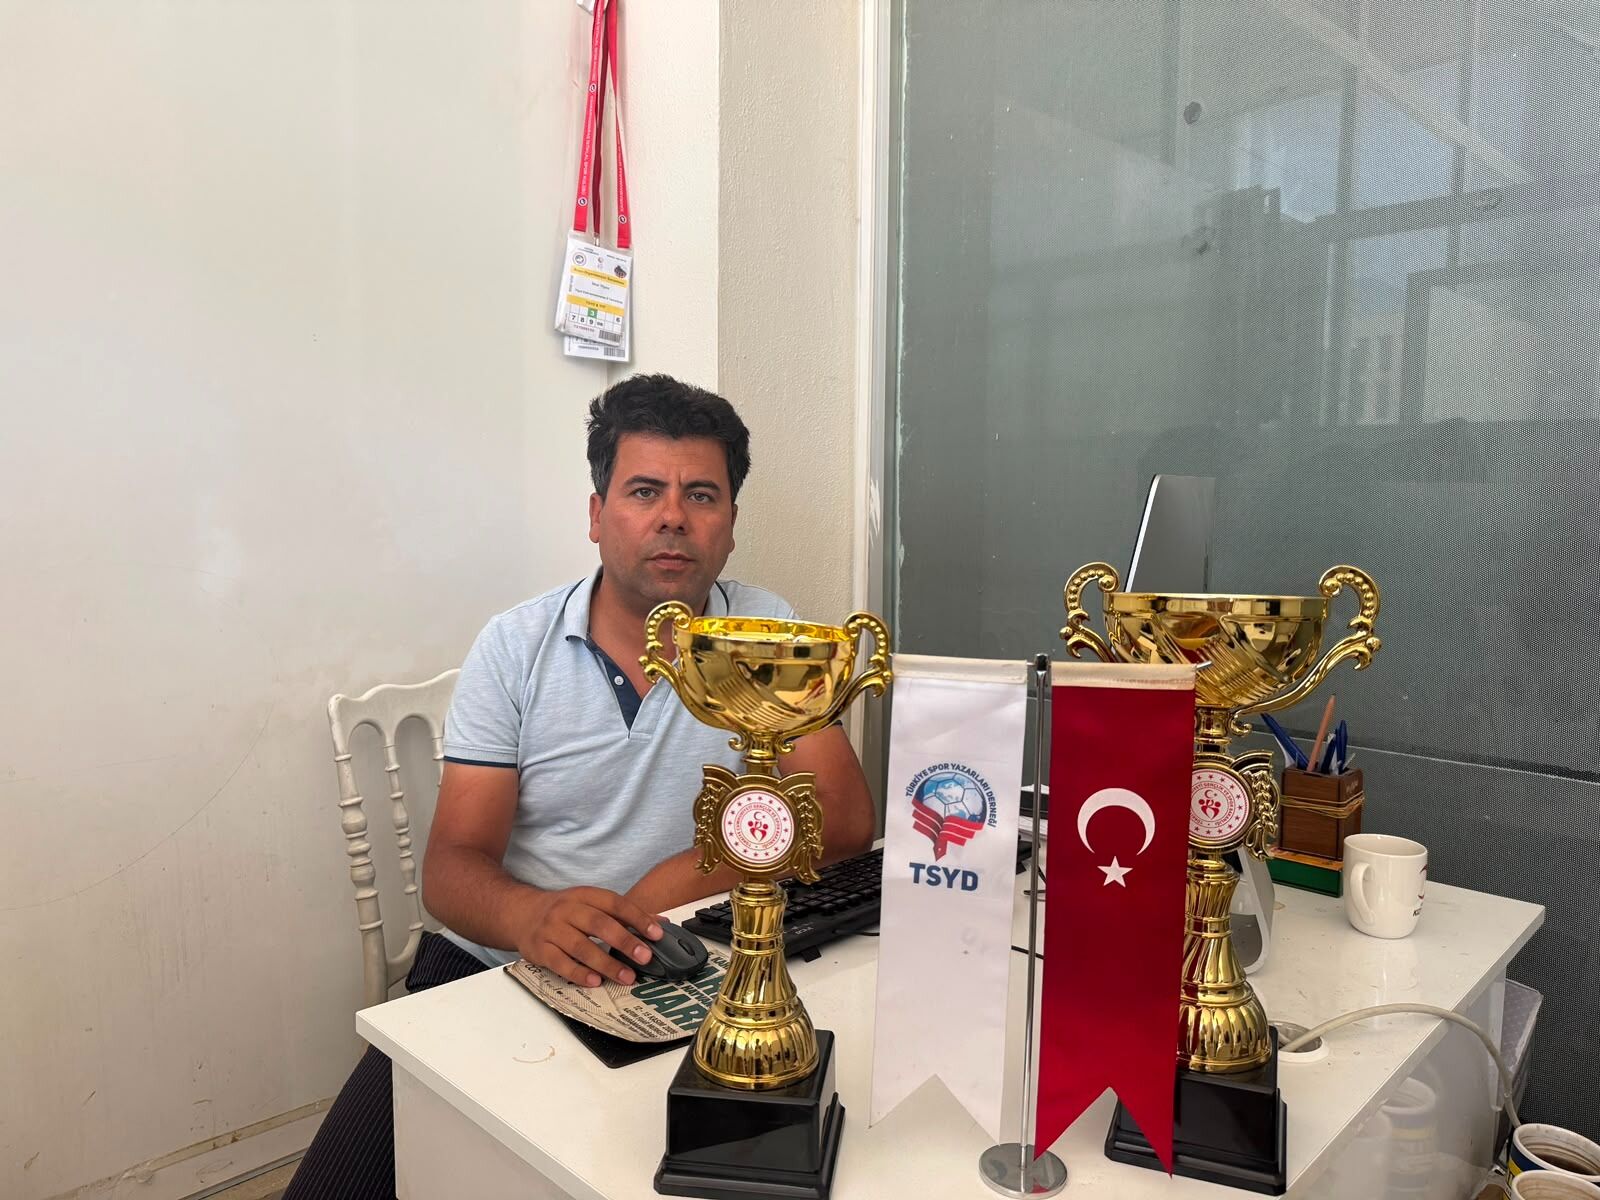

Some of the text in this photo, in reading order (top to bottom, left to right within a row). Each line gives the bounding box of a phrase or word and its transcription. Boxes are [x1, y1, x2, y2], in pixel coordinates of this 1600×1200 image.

[906, 762, 997, 828] TÜRKİYE SPOR YAZARLARI DERNEĞİ
[909, 862, 978, 892] TSYD
